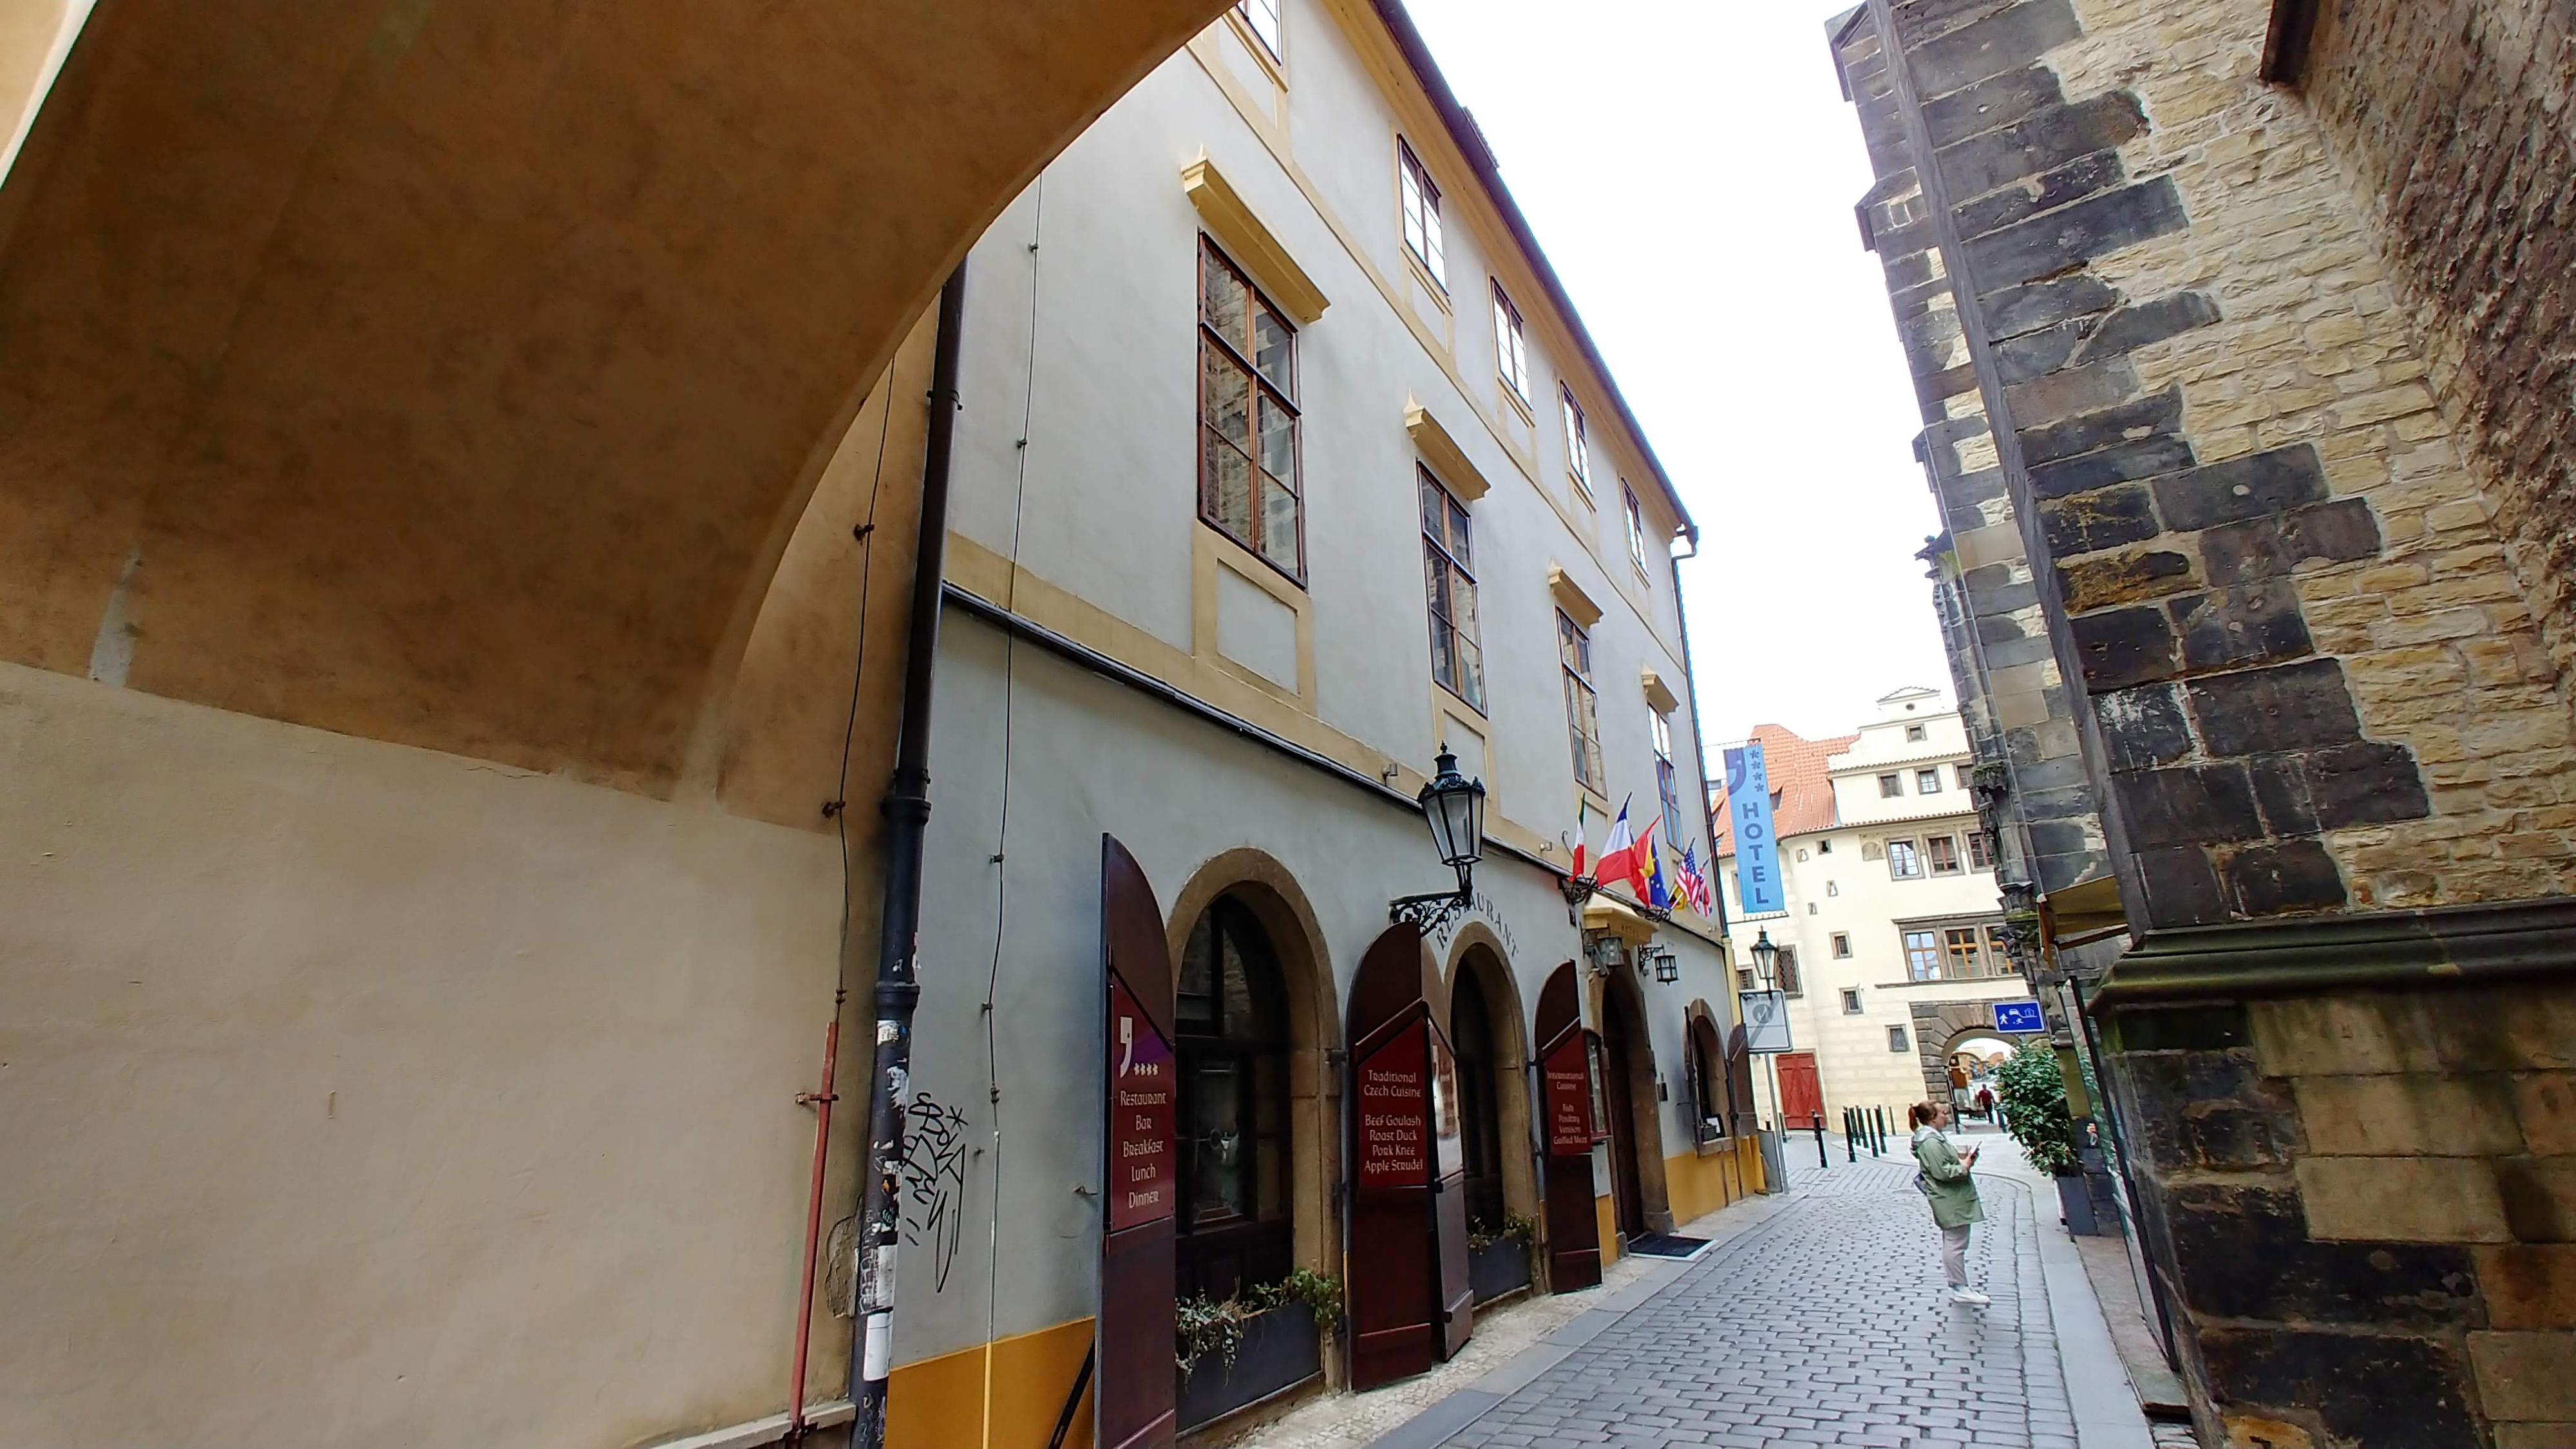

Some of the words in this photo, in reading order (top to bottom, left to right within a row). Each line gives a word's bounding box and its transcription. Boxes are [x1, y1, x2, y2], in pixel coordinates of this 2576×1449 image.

[1742, 802, 1769, 904] HOTEL
[1436, 892, 1519, 958] RSAURANT
[1367, 1070, 1416, 1083] Traditional
[1120, 1090, 1167, 1106] Restaurant
[1363, 1084, 1388, 1097] Czech
[1390, 1085, 1421, 1097] Cuisine
[1135, 1115, 1152, 1131] Bar
[1365, 1115, 1385, 1126] Beef
[1386, 1115, 1421, 1126] Goulash
[1369, 1130, 1394, 1142] Roast
[1396, 1130, 1417, 1141] Duck
[1123, 1139, 1164, 1158] Breakfast
[1372, 1144, 1393, 1157] Pork
[1395, 1144, 1415, 1156] Knee
[1131, 1164, 1156, 1182] Lunch
[1364, 1160, 1389, 1174] Apple
[1391, 1159, 1423, 1171] Strudel
[1128, 1189, 1160, 1209] Dinner
